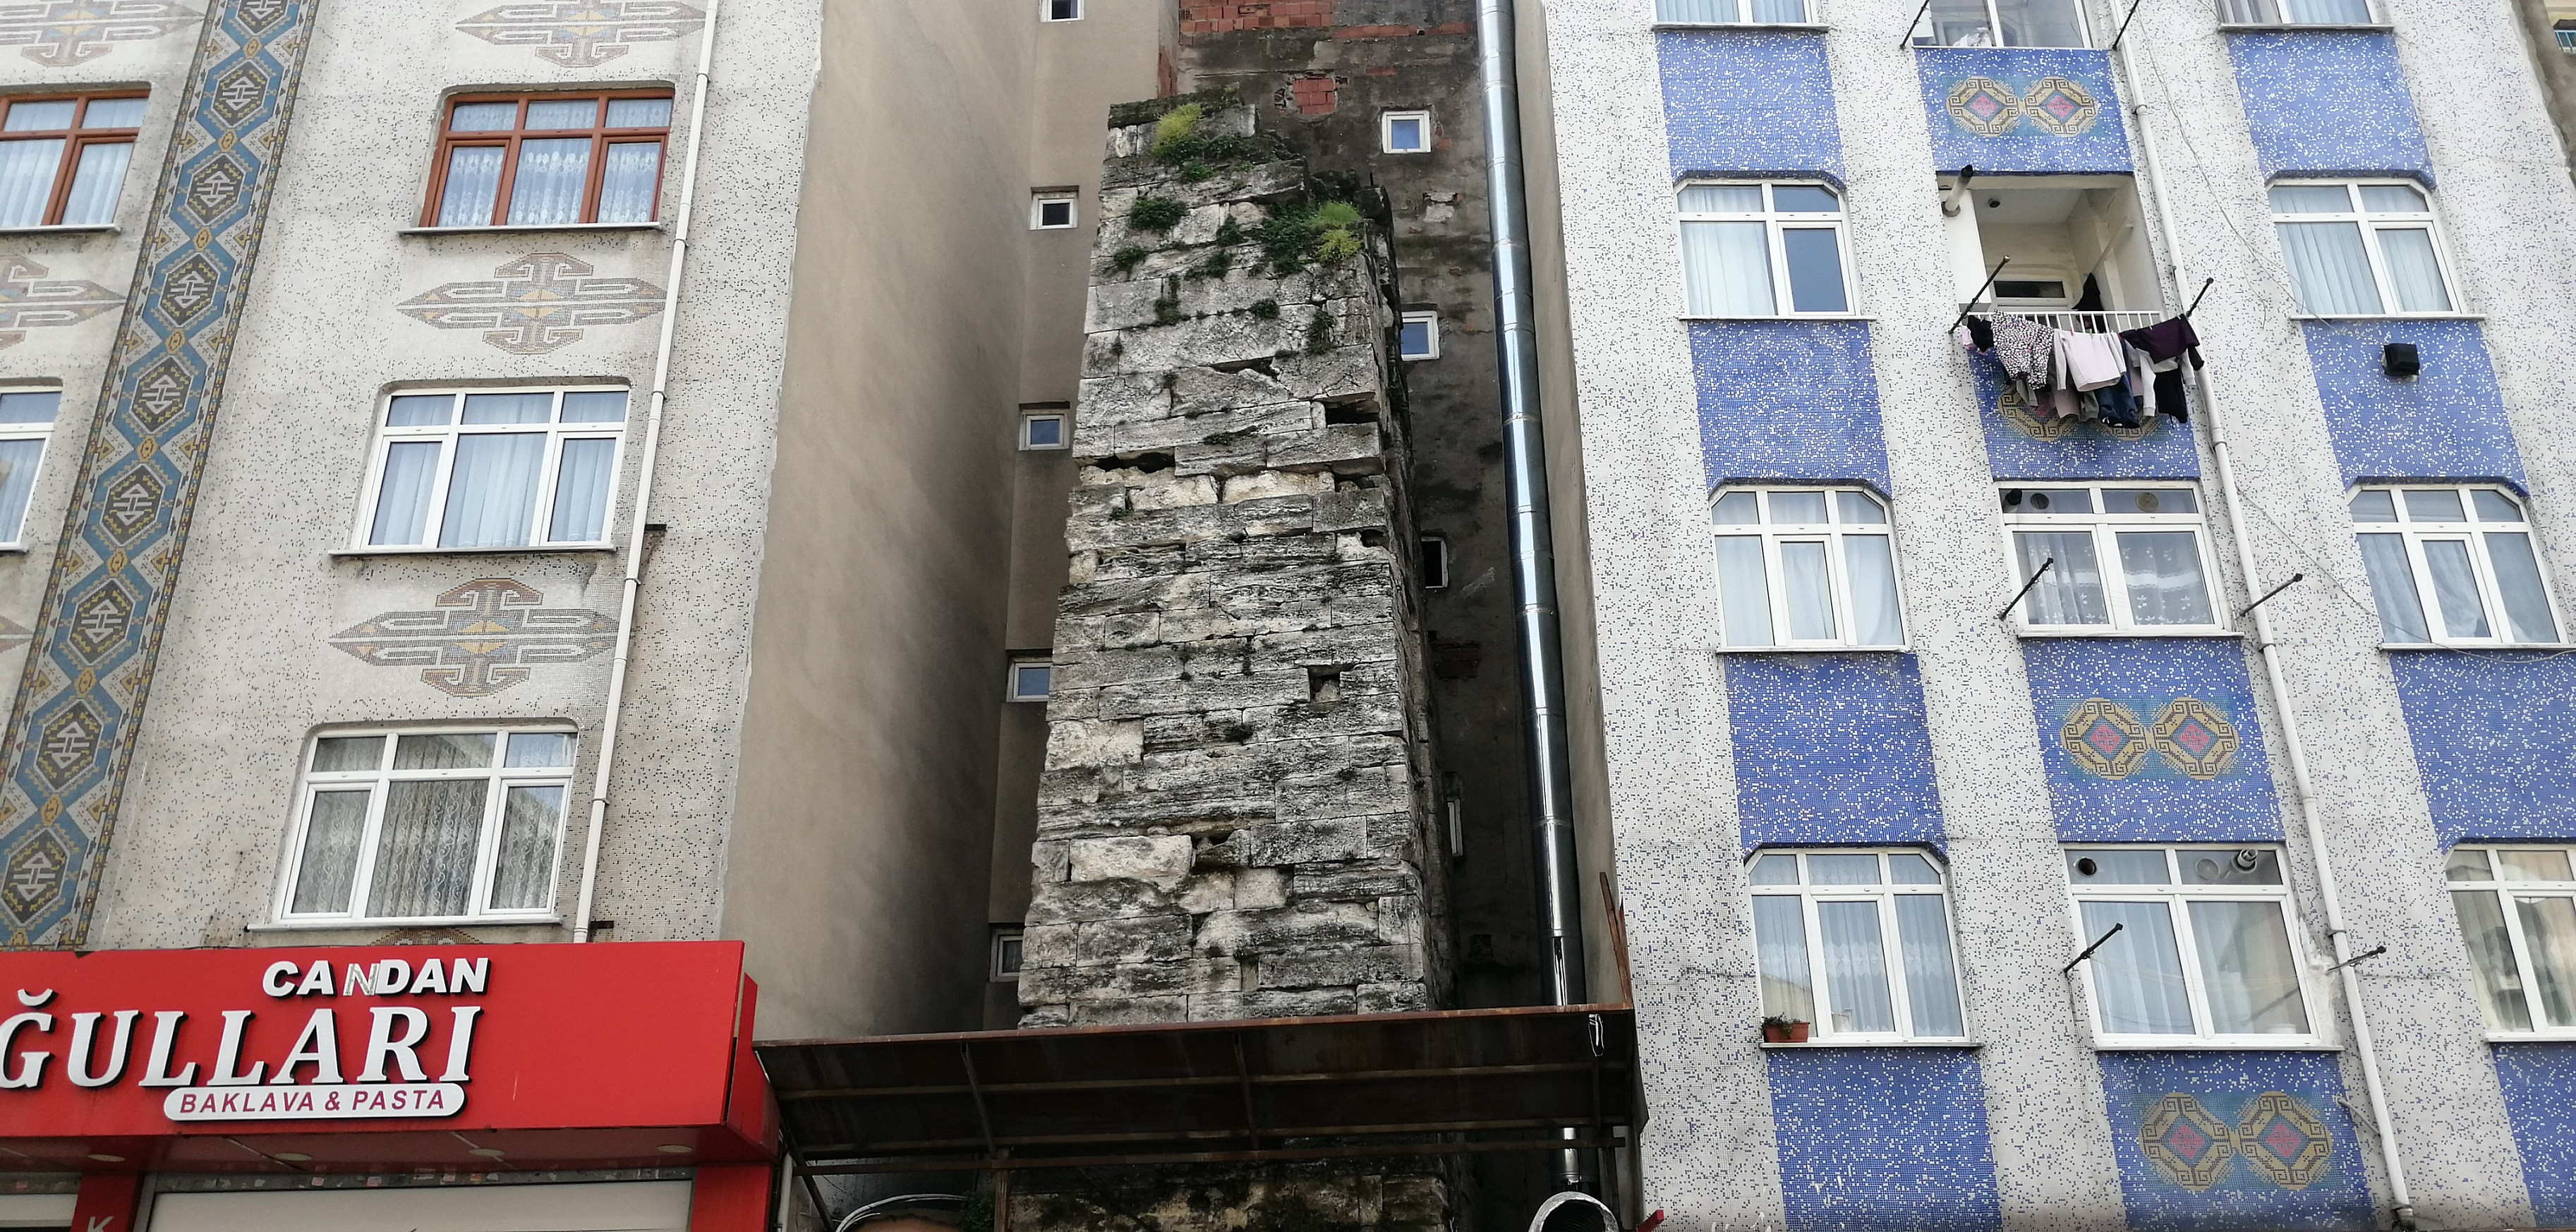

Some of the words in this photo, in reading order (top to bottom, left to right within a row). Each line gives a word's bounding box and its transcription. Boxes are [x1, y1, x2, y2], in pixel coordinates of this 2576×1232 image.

[262, 958, 488, 996] CANDAN
[0, 988, 481, 1088] ĞULLARI
[180, 1092, 314, 1113] BAKLAVA
[325, 1092, 340, 1111] &
[352, 1089, 444, 1111] PASTA
